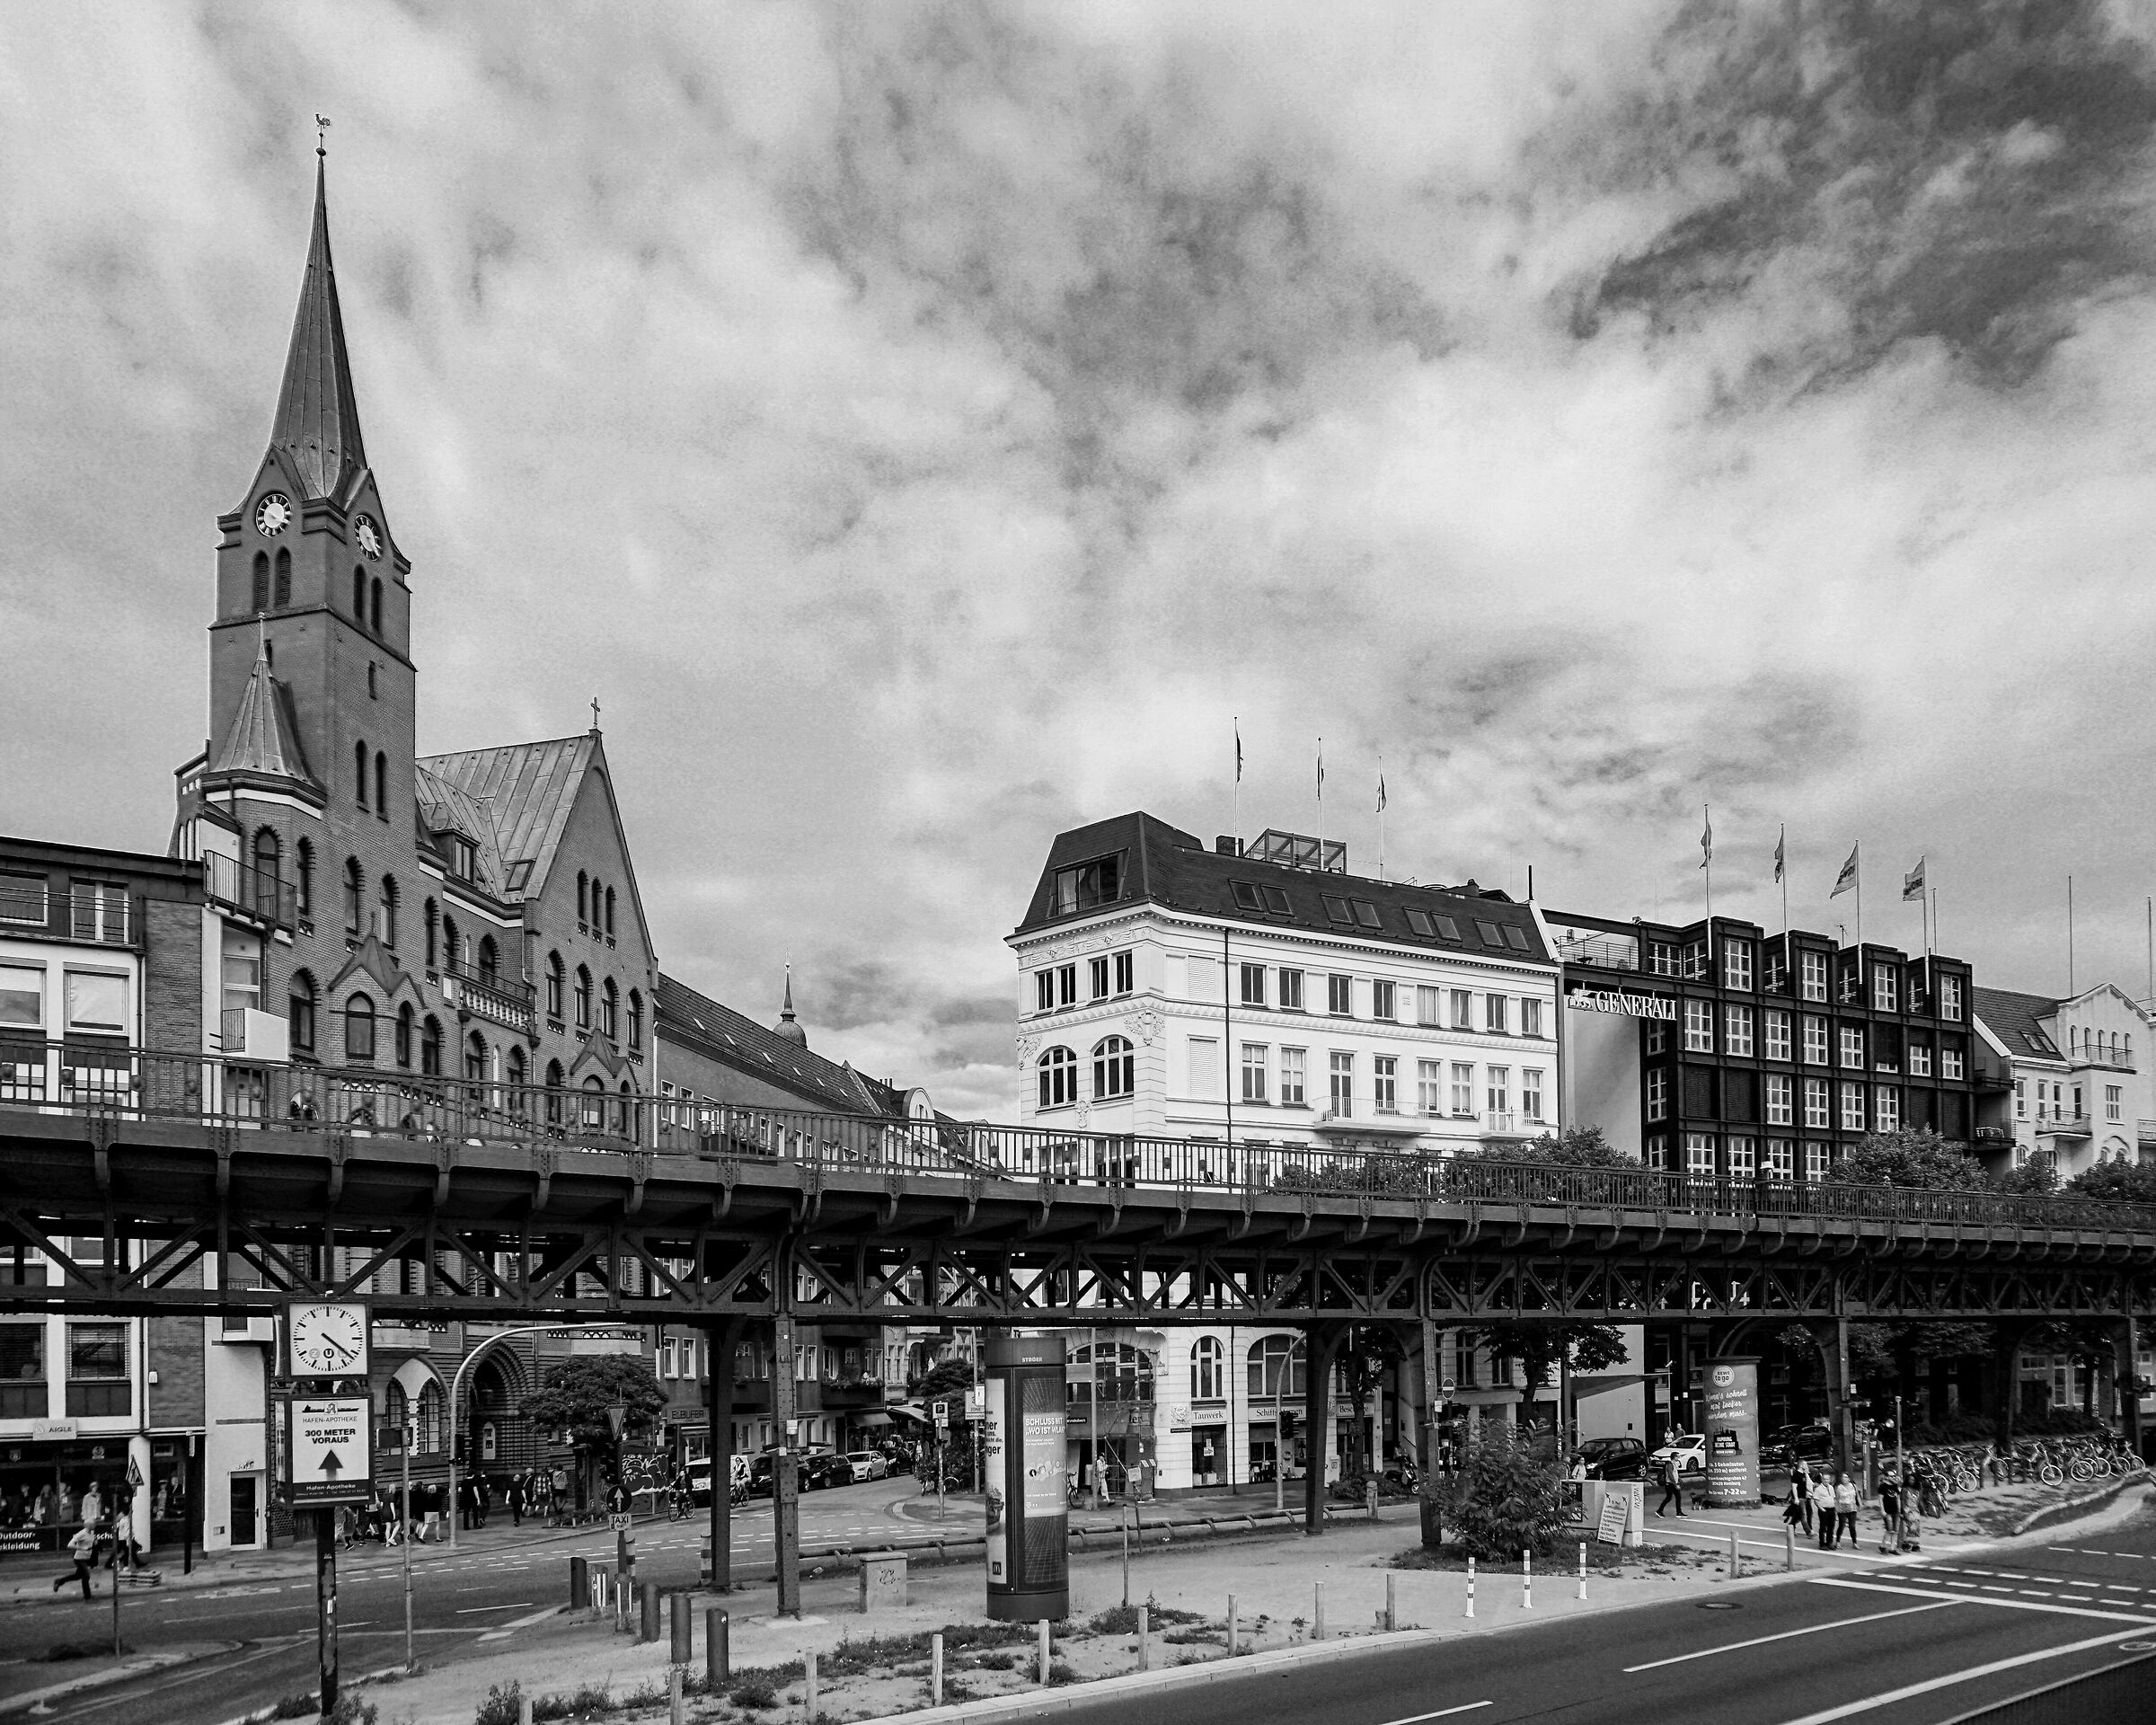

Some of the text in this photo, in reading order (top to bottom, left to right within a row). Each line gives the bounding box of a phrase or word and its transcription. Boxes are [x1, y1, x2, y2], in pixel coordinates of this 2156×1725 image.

[1595, 991, 1677, 1021] GENERALI
[302, 1415, 358, 1423] HAFEN-APOTHEKE
[1193, 1411, 1224, 1420] Tauwerk
[1025, 1417, 1055, 1426] SCHLUSS
[1041, 1426, 1051, 1435] IST
[611, 1516, 629, 1524] TAXI
[0, 1541, 40, 1551] ekleidung
